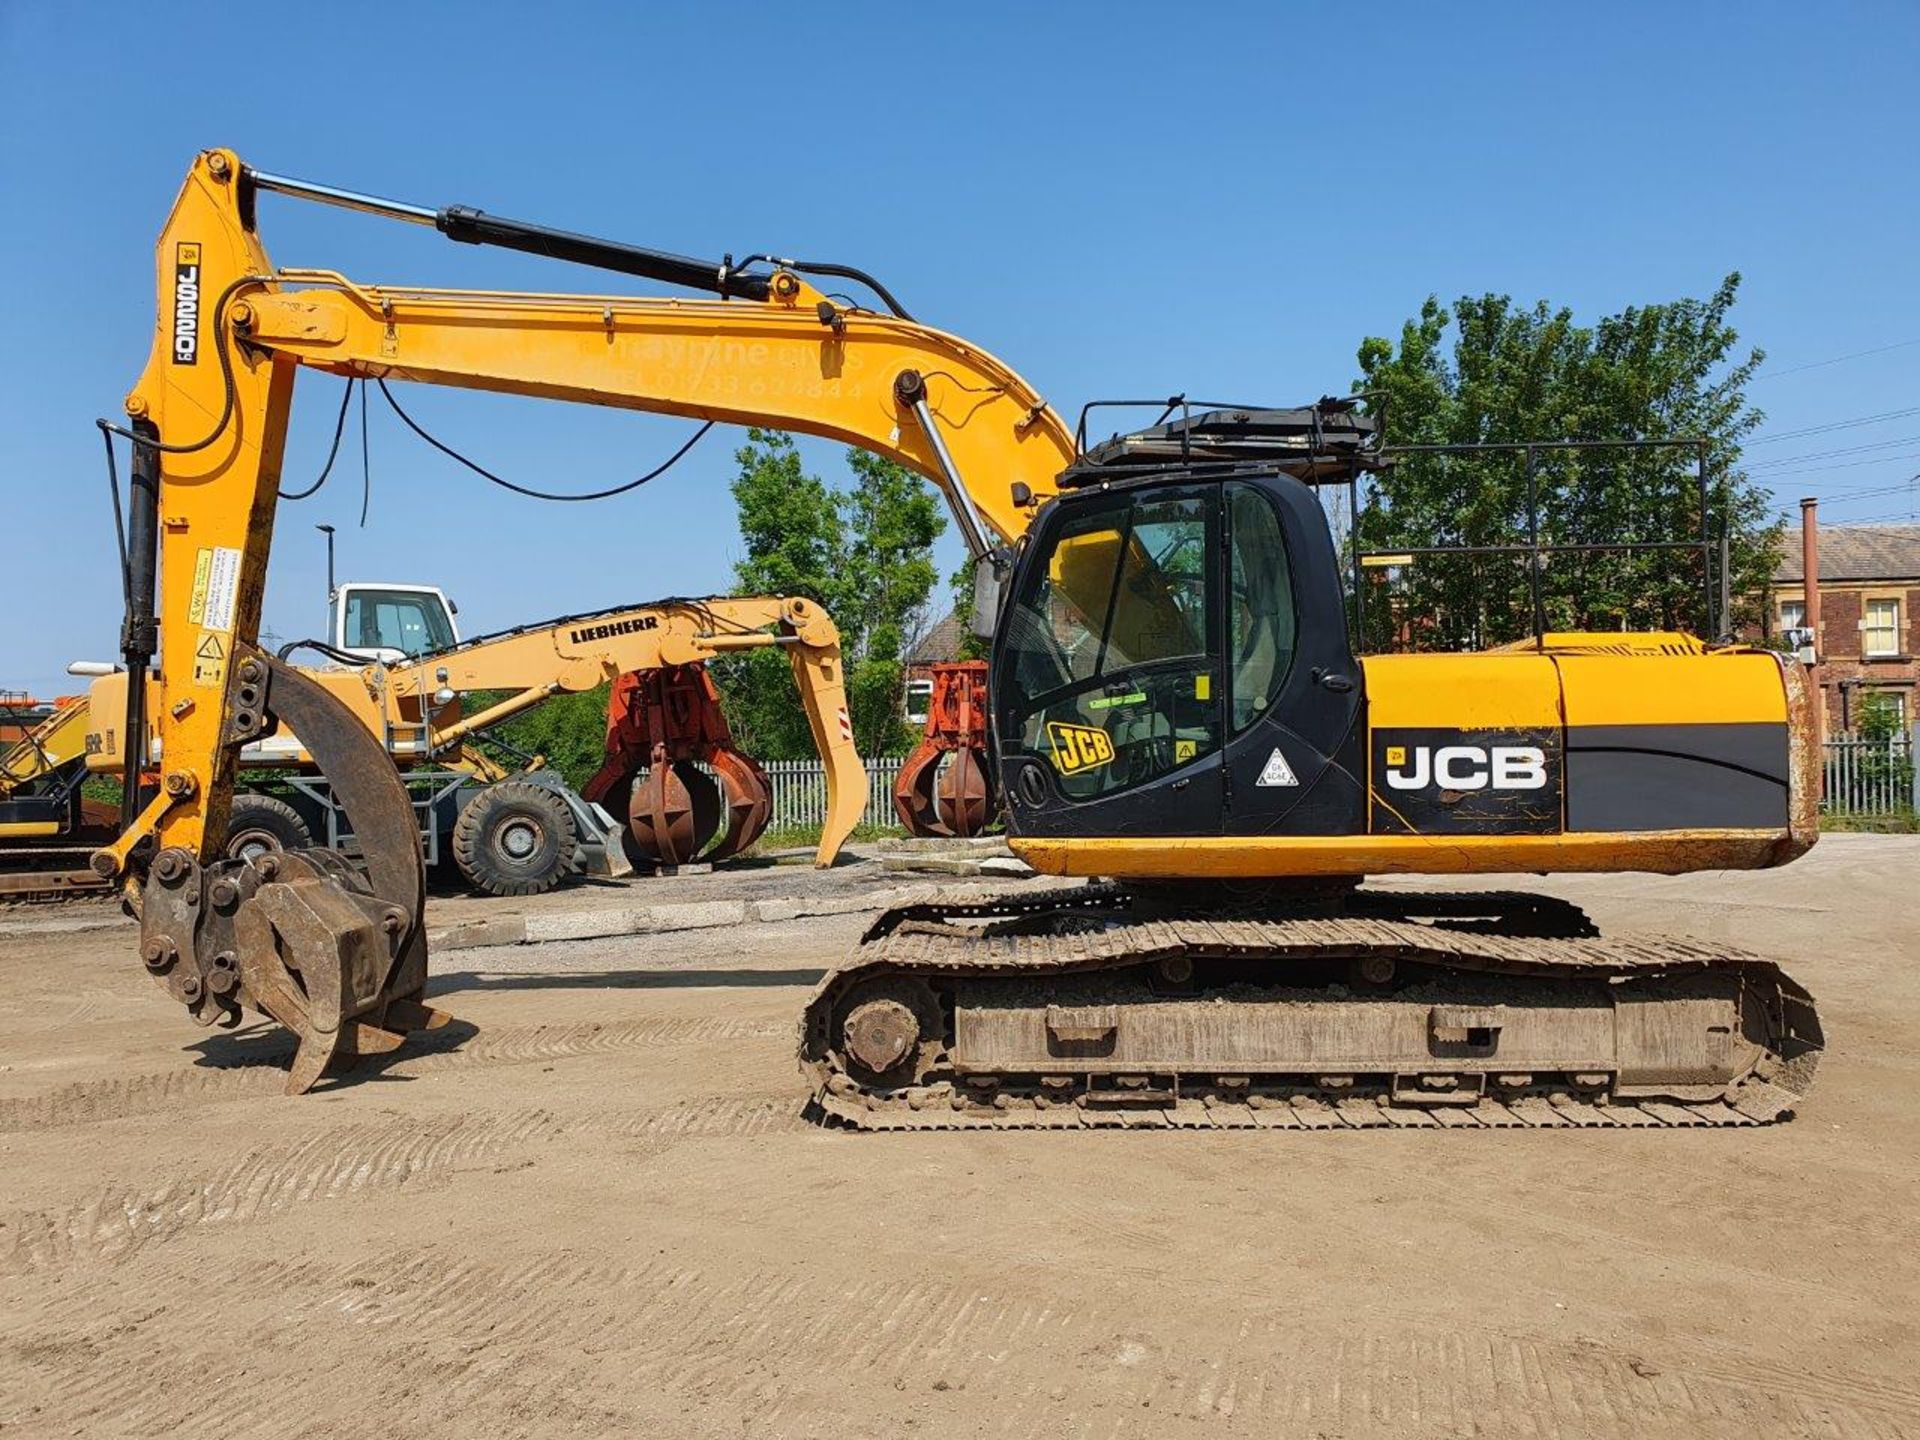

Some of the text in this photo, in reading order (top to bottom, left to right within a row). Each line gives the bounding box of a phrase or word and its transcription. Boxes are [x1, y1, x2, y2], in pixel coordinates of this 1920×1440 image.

[175, 266, 198, 353] JS220
[570, 616, 659, 645] LIEBHERR
[1059, 728, 1111, 769] JCB
[1386, 746, 1547, 790] JCB
